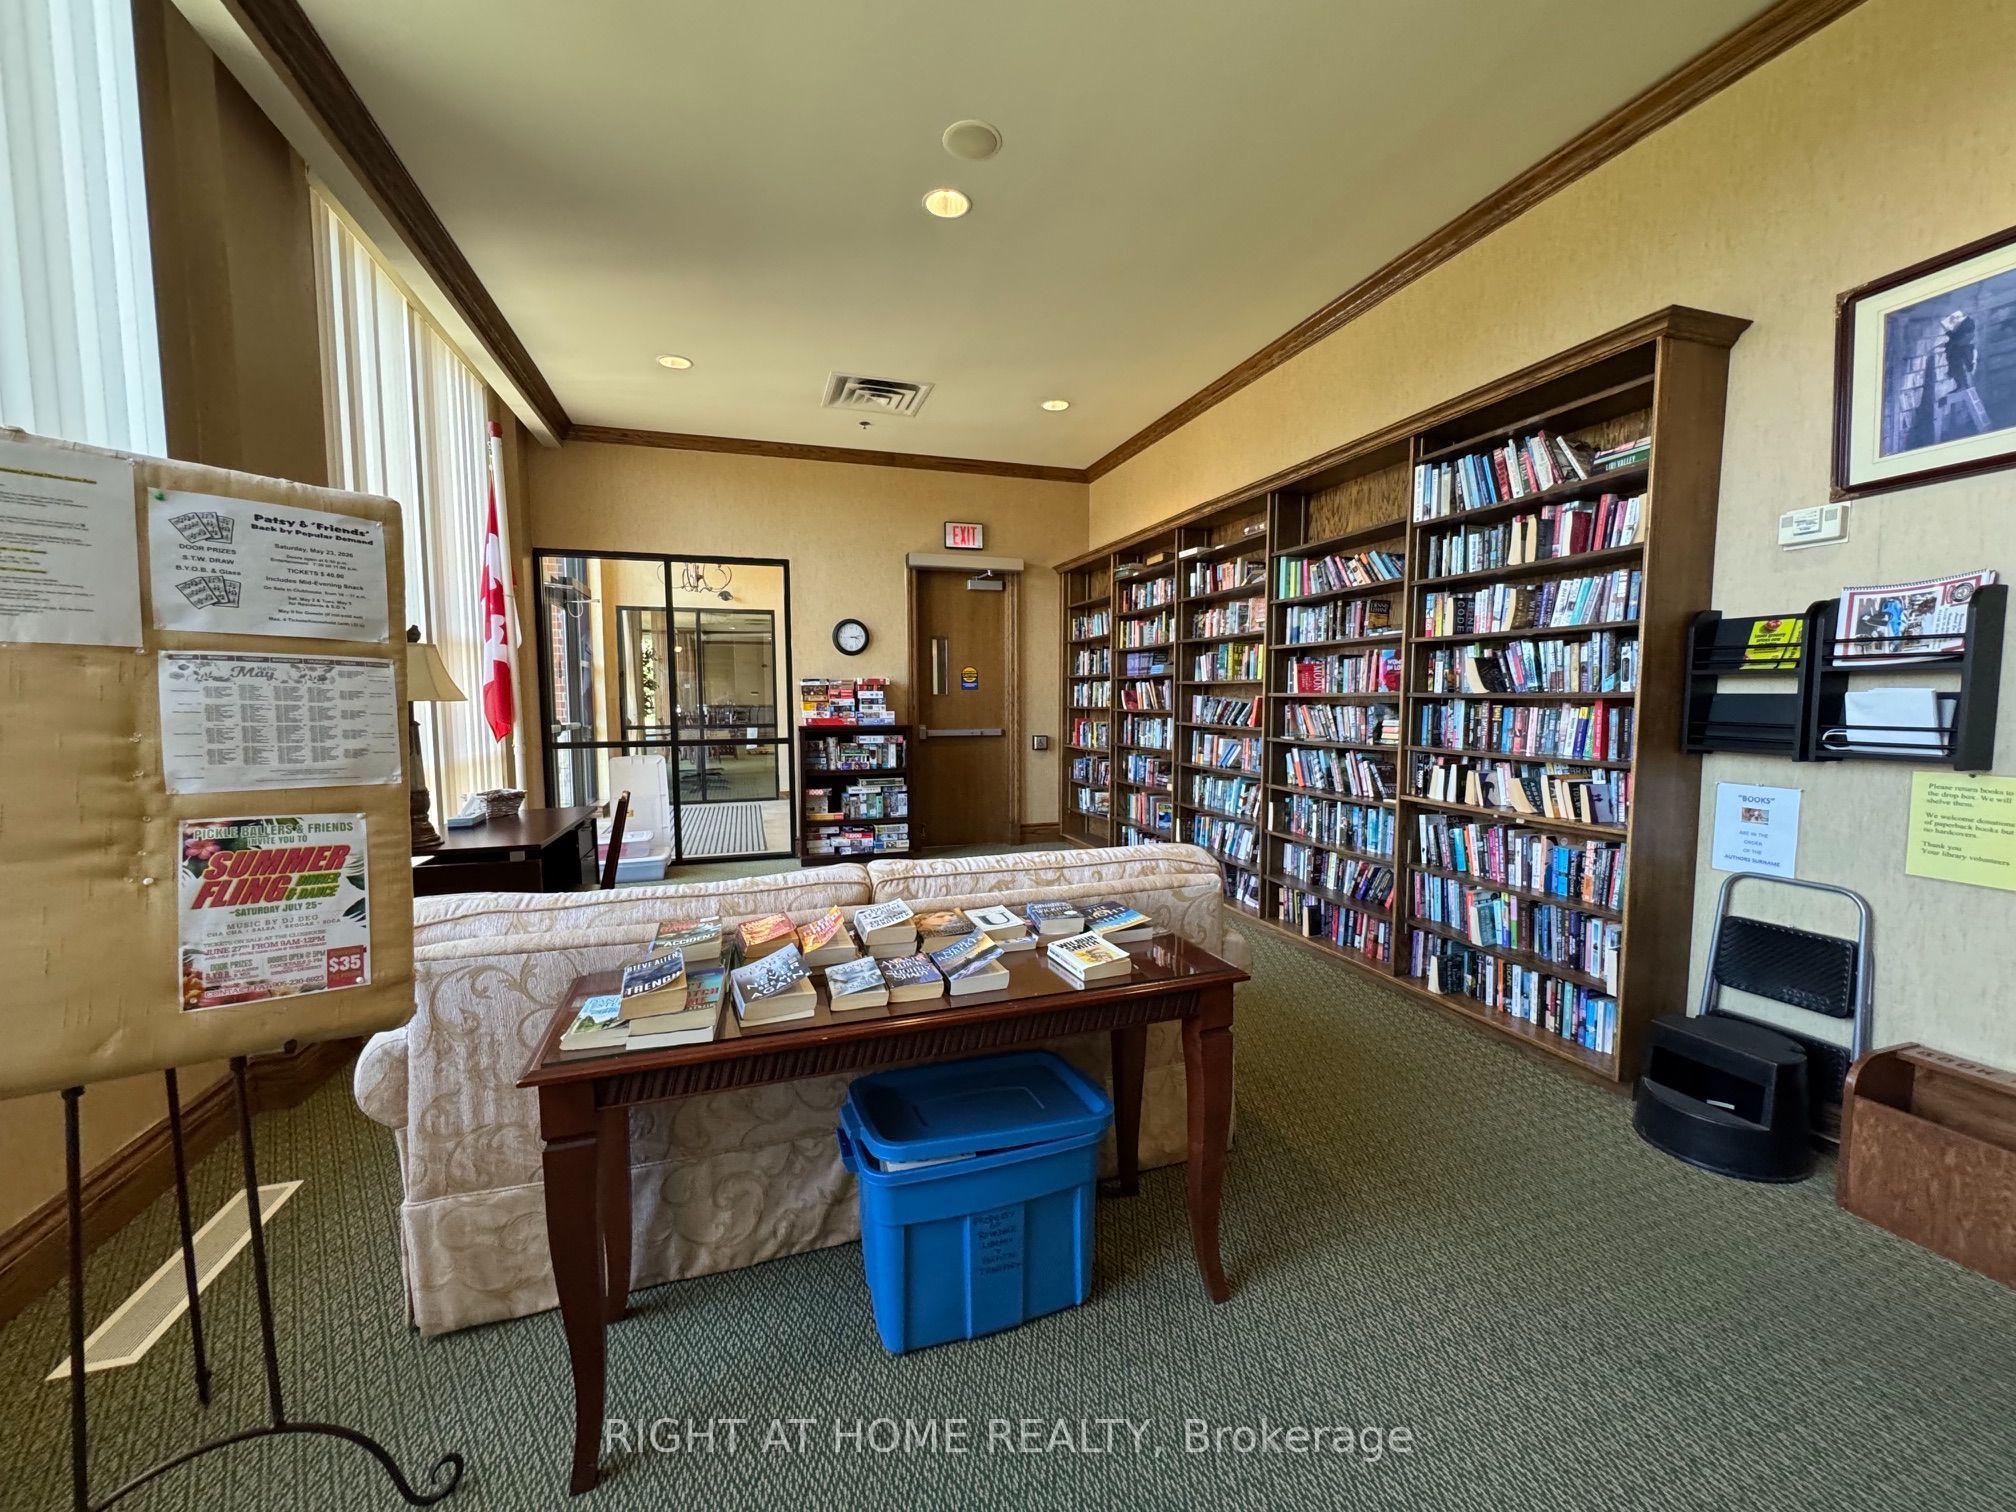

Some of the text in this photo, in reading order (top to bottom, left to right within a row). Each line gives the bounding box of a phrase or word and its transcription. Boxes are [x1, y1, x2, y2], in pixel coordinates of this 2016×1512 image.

[254, 514, 295, 528] Patsy
[299, 520, 308, 528] &
[251, 524, 374, 546] Back by Popular Demand
[952, 526, 977, 546] EXIT
[178, 543, 237, 555] DOOR PRIZES
[274, 544, 309, 554] Saturday,
[310, 548, 324, 556] May
[182, 554, 236, 565] S.T.W. DRAW
[176, 564, 208, 573] B.Y.O.B.
[219, 568, 242, 576] Glass
[286, 568, 319, 577] TICKETS
[266, 576, 297, 584] Includes
[299, 580, 343, 589] Mid-Evening
[1457, 601, 1466, 632] CODE
[230, 666, 278, 681] May
[1928, 783, 1953, 791] Please
[1980, 788, 2004, 796] books
[1941, 791, 1960, 800] drop
[1738, 794, 1776, 805] "BOOKS"
[1926, 798, 1974, 808] shelve them.
[1940, 814, 1976, 823] welcome
[1976, 818, 2016, 828] donations
[194, 822, 354, 840] PICKLE BALLERS & FRIENDS
[1934, 821, 1973, 831] paperback
[1975, 825, 1999, 834] books
[2001, 828, 2015, 836] but
[248, 835, 308, 847] INVITE YOU TO
[1922, 840, 1962, 852] Thank you
[203, 844, 351, 881] SUMMER
[1724, 854, 1781, 868] AUTHORS SURNAME
[1922, 848, 2011, 867] Your library volunteers
[295, 872, 342, 887] DINNER
[192, 874, 293, 910] FLING
[297, 884, 340, 899] DANCE
[282, 902, 303, 912] JULY
[1087, 905, 1108, 913] THE
[1088, 906, 1126, 920] NIGHT
[226, 920, 261, 931] MUSIC
[265, 918, 279, 927] BY
[282, 916, 296, 925] DJ
[252, 926, 276, 934] SALSA
[322, 918, 342, 926] SOCA
[976, 912, 1011, 926] U
[204, 940, 232, 949] TICKETS
[246, 936, 263, 945] SALE
[288, 929, 327, 938] CLUBHOUSE
[664, 932, 717, 947] ACCIDENT
[1056, 936, 1097, 949] WILBUR
[205, 946, 232, 956] JUNE
[252, 941, 280, 951] FROM
[1066, 940, 1100, 953] SMITH
[230, 959, 253, 969] PRIZES
[268, 955, 288, 965] DOORS
[288, 953, 304, 962] OPEN
[329, 954, 362, 973] $35
[626, 952, 679, 974] STEVE ALTEN
[882, 954, 926, 967] AMANDA
[890, 960, 922, 970] QUICK
[894, 970, 929, 981] SHADY
[626, 970, 681, 996] TRENCH
[205, 986, 250, 998] CONTACT
